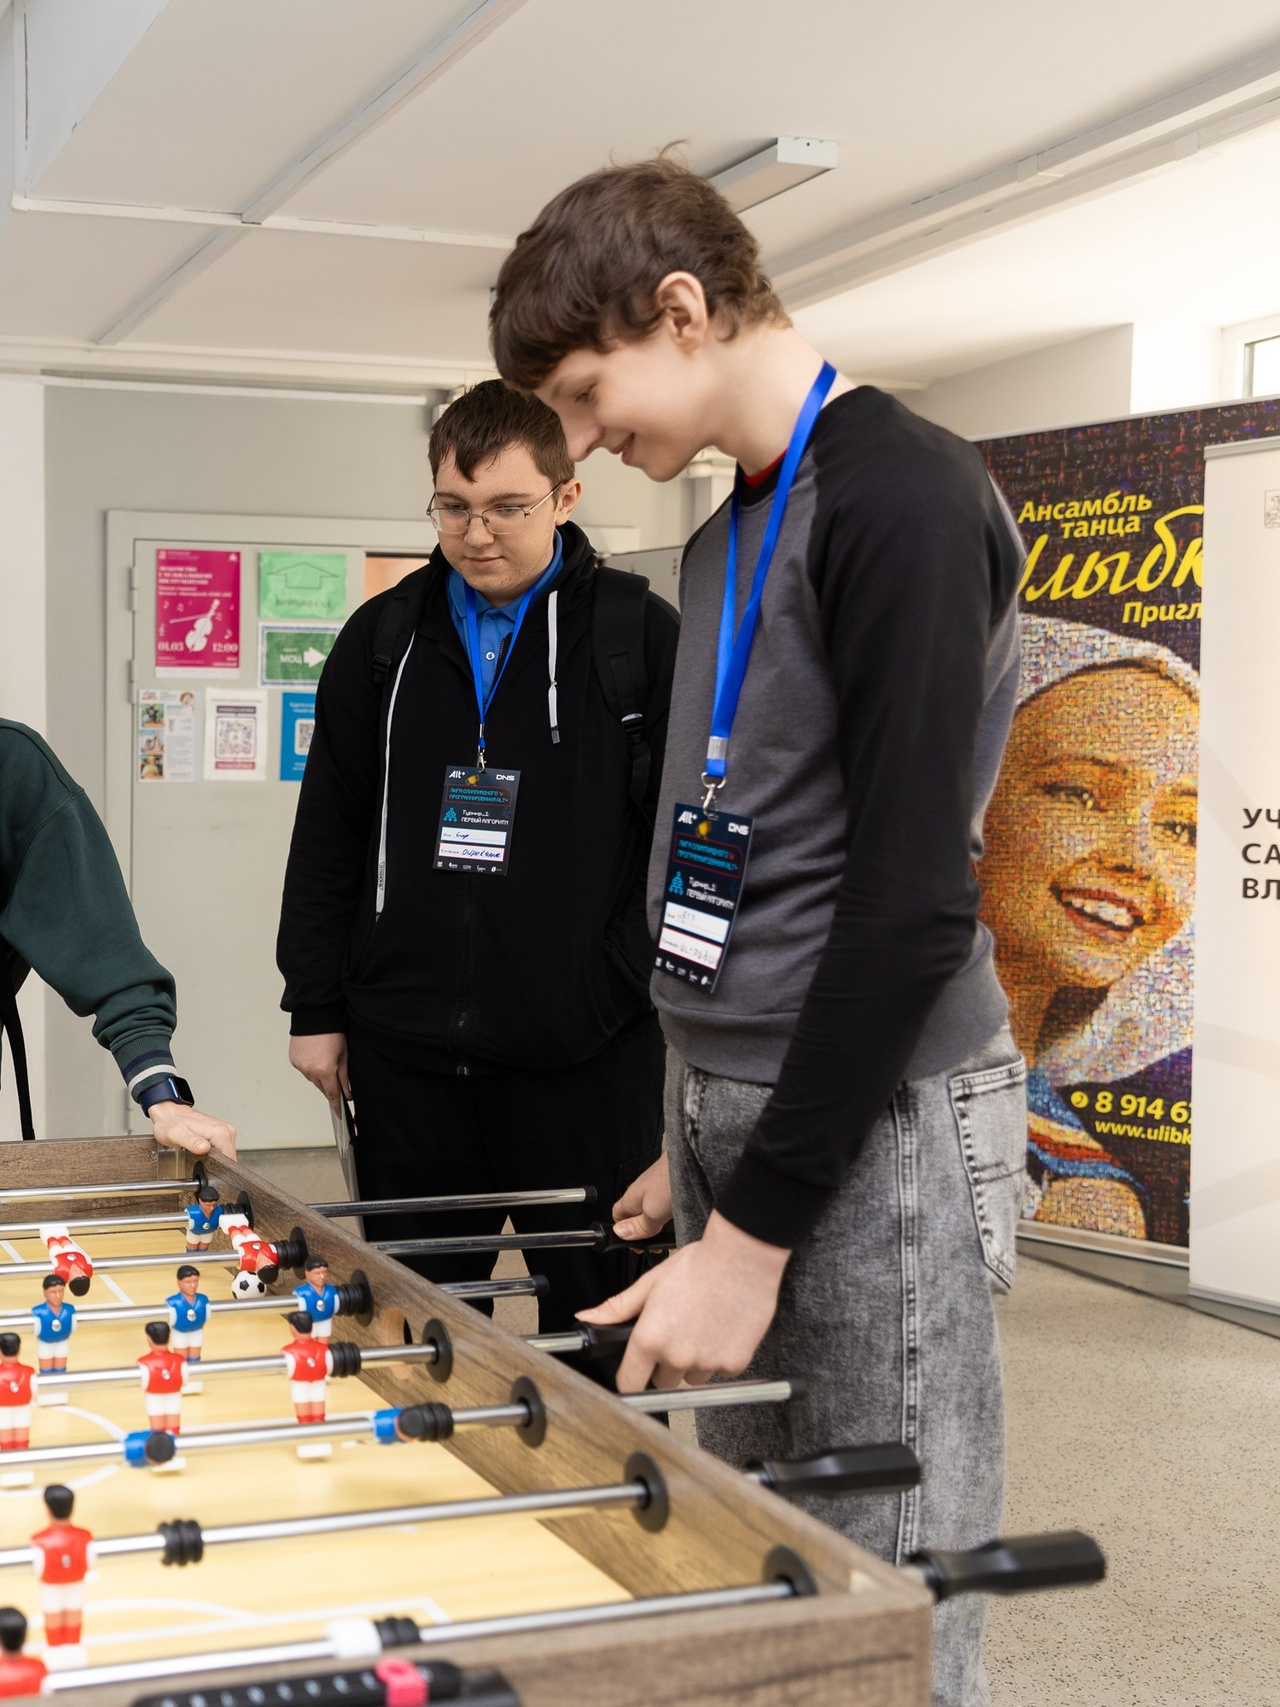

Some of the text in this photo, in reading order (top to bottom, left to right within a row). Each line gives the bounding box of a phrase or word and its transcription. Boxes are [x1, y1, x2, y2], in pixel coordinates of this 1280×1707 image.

[1017, 490, 1153, 524] Ансамбль
[1061, 514, 1141, 539] танца
[495, 774, 515, 782] DNS
[727, 822, 749, 836] DNS
[1094, 1091, 1191, 1124] 8 914 6
[1094, 1120, 1191, 1146] www.ulibk
